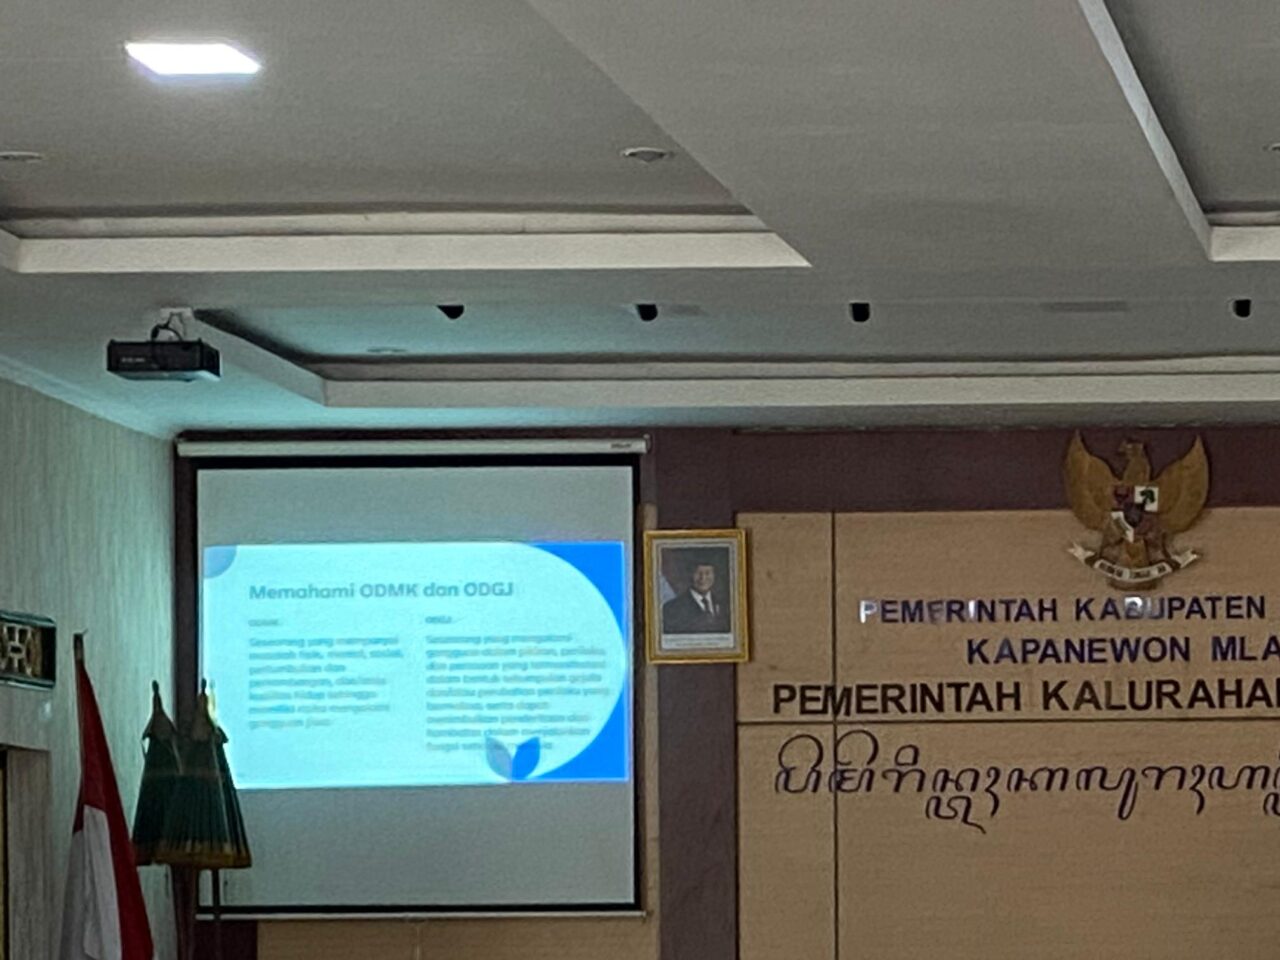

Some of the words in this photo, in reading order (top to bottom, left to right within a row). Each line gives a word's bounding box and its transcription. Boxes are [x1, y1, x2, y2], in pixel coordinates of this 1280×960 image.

[248, 583, 355, 599] Memahami
[360, 582, 418, 598] ODMK
[423, 582, 459, 597] dan
[464, 581, 514, 596] ODGJ
[859, 598, 1059, 623] PEMERINTAH
[1074, 595, 1267, 622] KABUPATEN
[966, 636, 1191, 665] KAPANEWON
[772, 682, 1021, 716] PEMERINTAH
